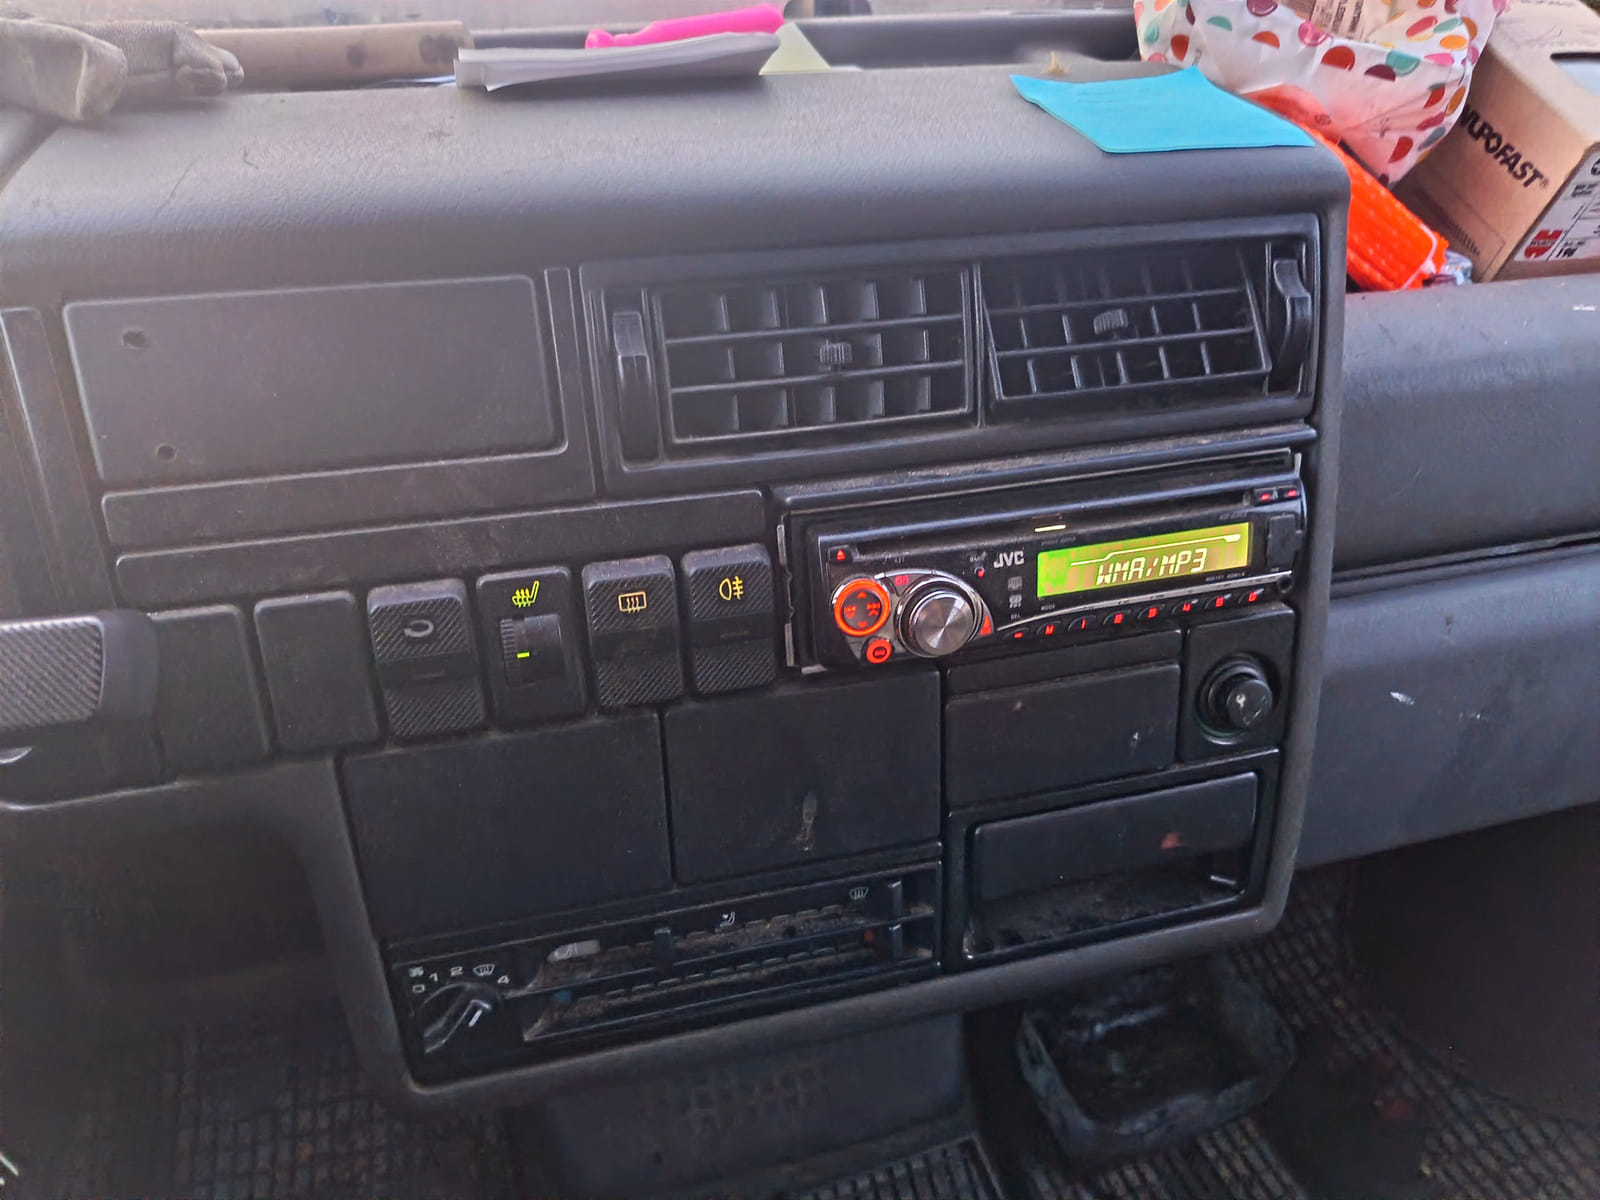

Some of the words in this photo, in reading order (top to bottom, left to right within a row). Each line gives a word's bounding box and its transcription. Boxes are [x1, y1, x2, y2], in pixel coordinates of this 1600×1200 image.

[993, 550, 1025, 568] JVC
[1097, 547, 1208, 586] WMA/MP3
[450, 966, 463, 977] 2
[497, 975, 511, 985] 4
